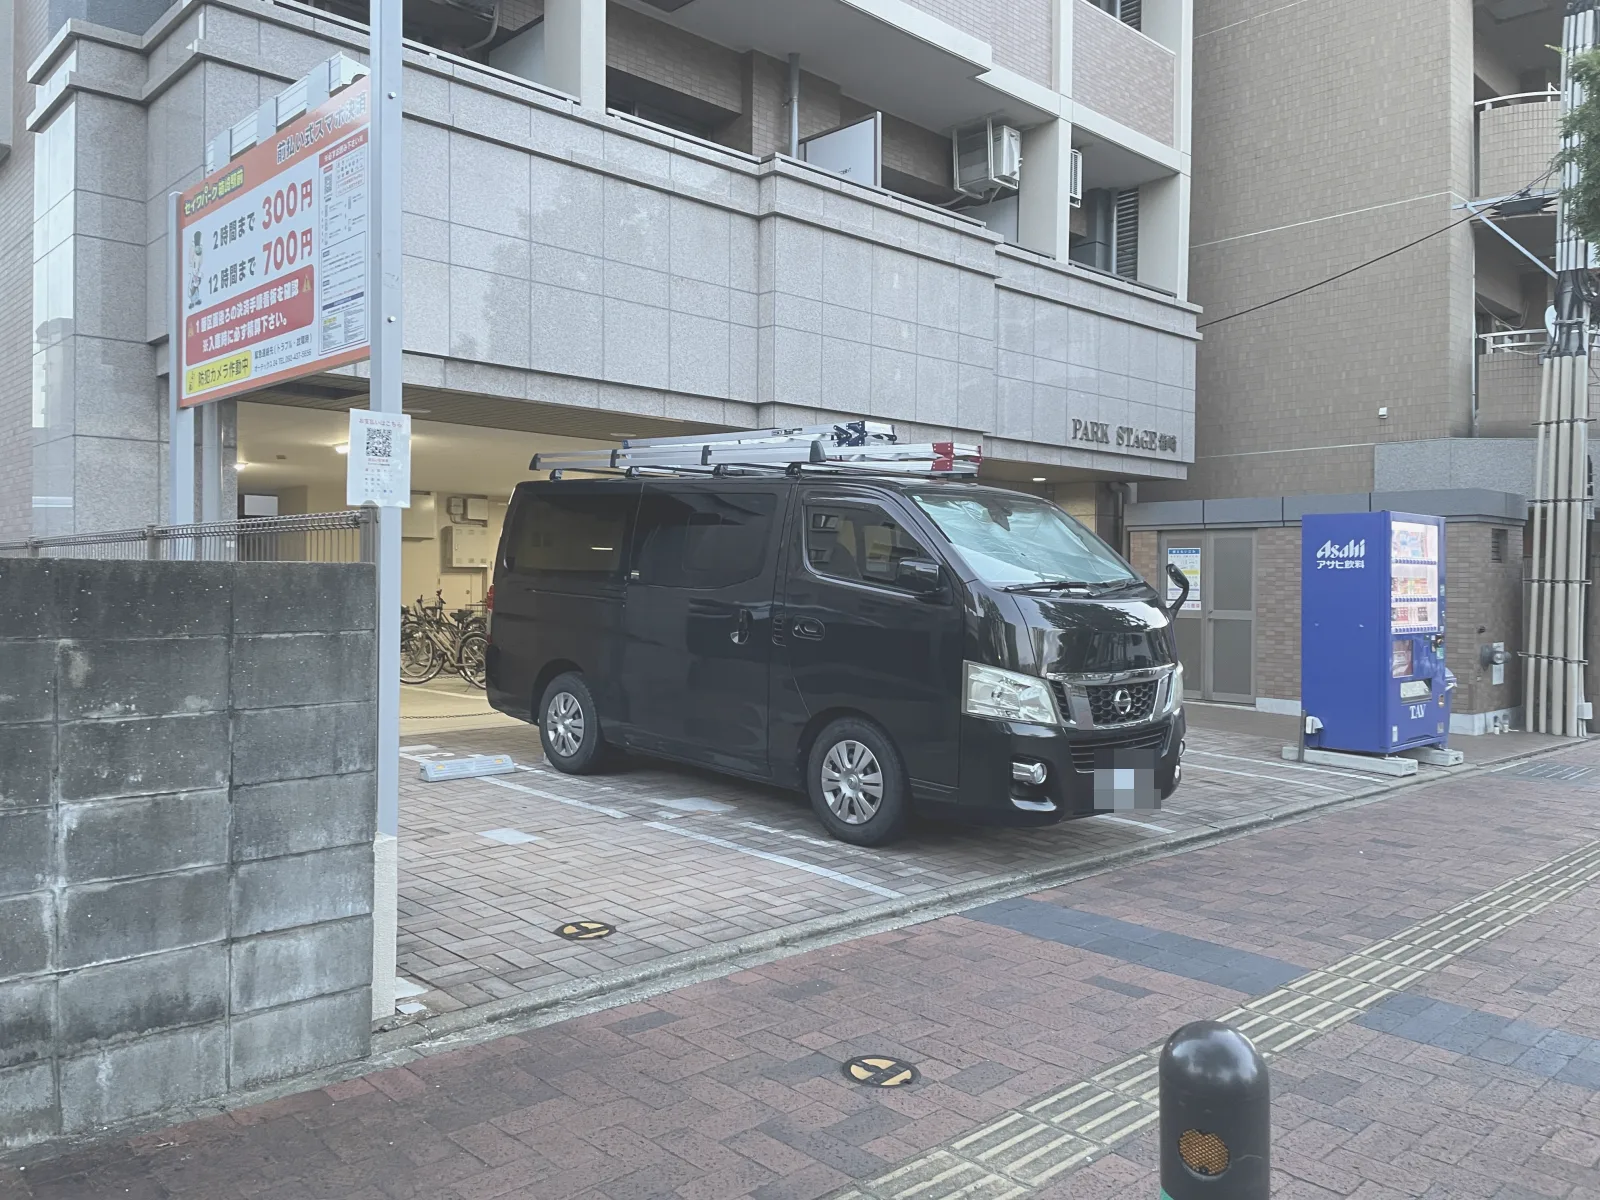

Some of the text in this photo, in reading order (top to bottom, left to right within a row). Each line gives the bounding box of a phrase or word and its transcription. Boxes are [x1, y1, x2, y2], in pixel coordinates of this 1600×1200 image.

[212, 212, 256, 250] 2時間まで
[262, 178, 313, 230] 300円
[208, 256, 256, 295] 12時間まで
[262, 227, 313, 276] 700円
[1071, 418, 1110, 444] PARK
[1116, 426, 1157, 450] STAGE
[1316, 539, 1366, 559] Asahi
[1316, 560, 1365, 569] アサヒ飲料
